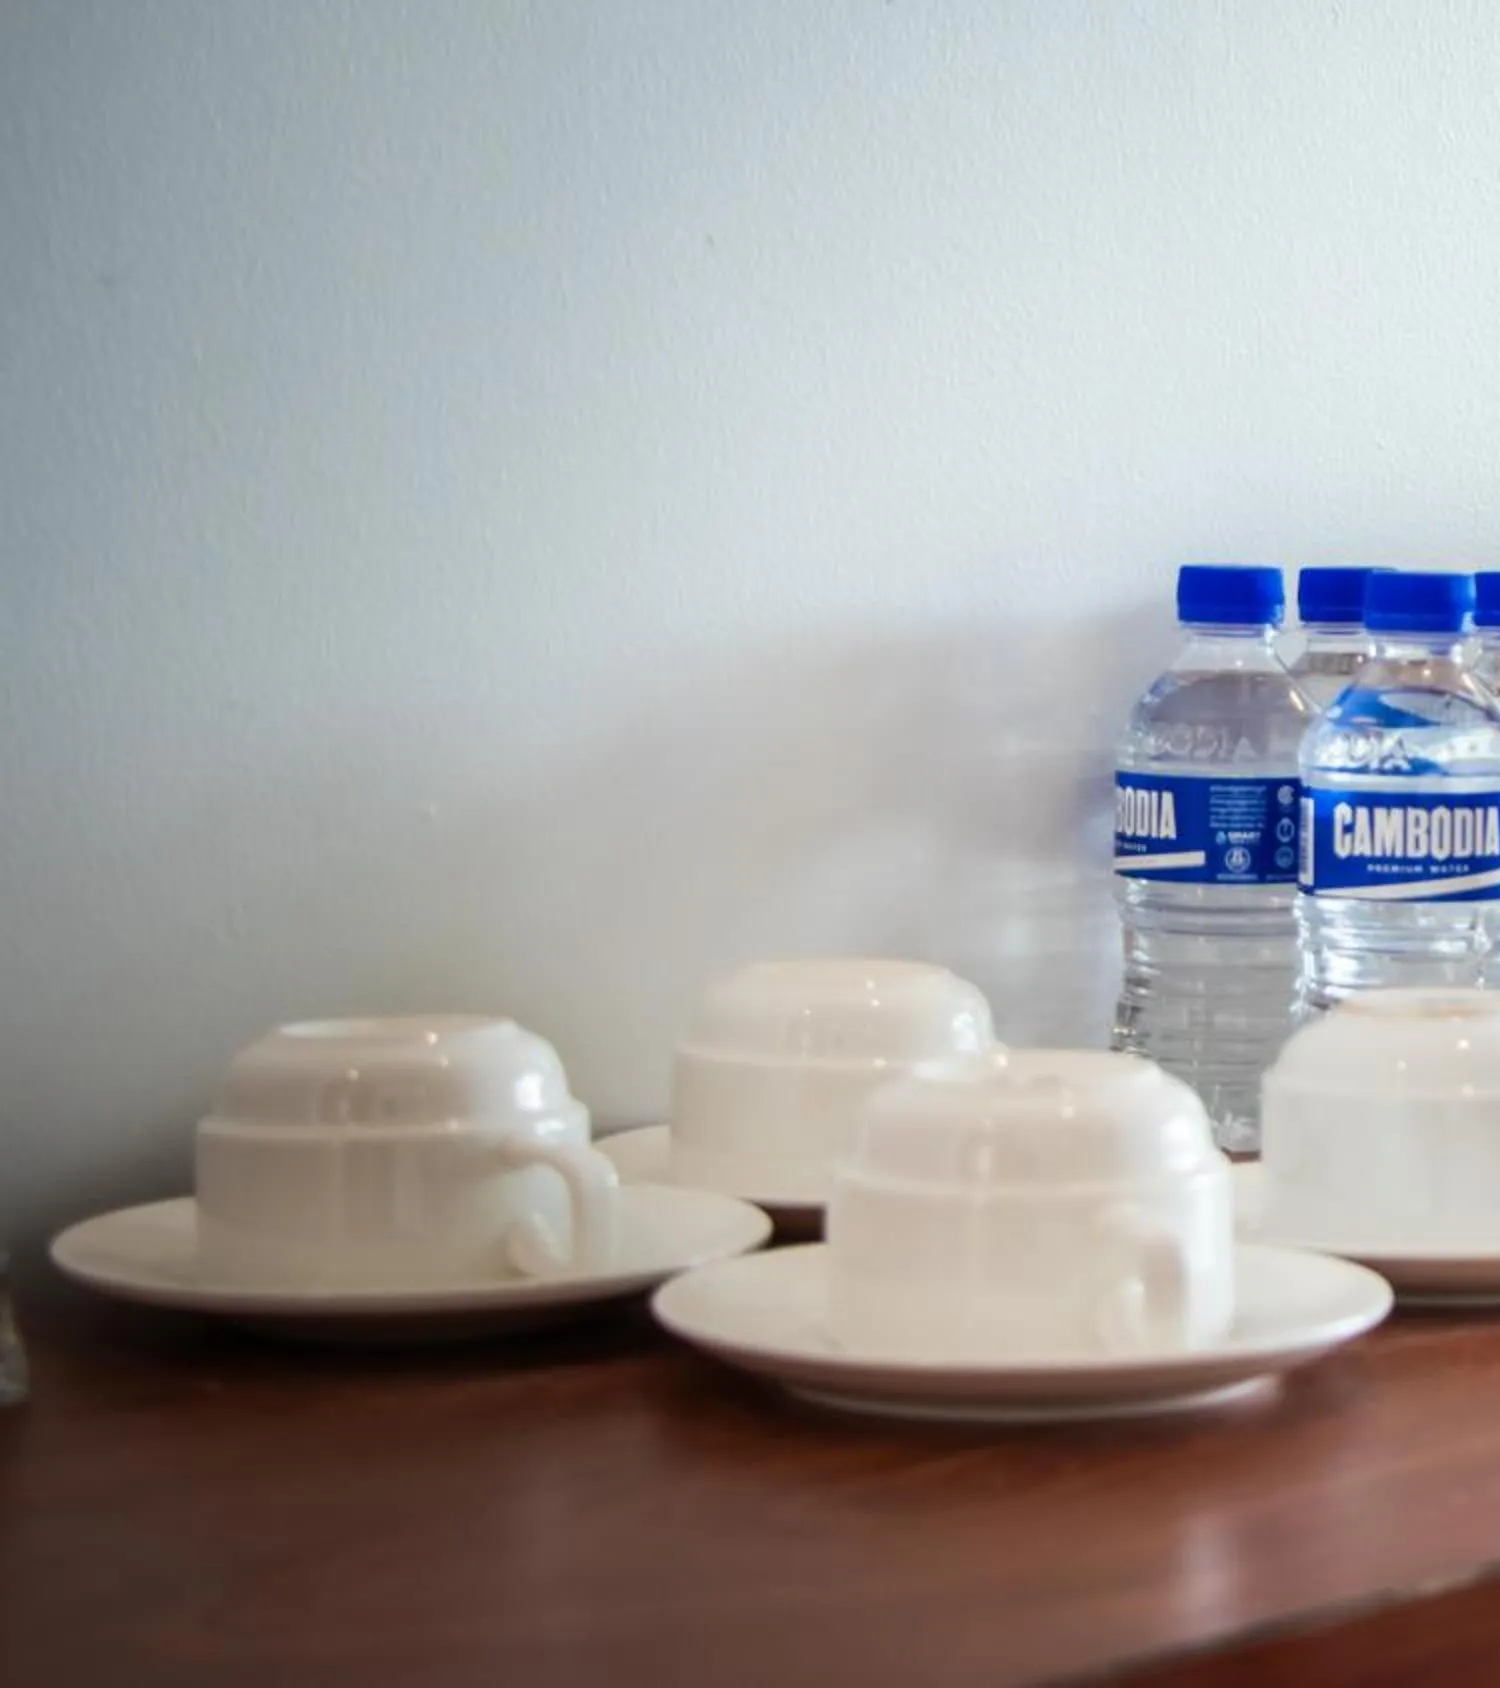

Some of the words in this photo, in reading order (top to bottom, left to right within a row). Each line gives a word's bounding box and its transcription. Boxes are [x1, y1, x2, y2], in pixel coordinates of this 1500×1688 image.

[1333, 802, 1500, 859] CAMBODIA
[1366, 863, 1424, 874] PREMIUM
[1429, 863, 1470, 874] WATER
